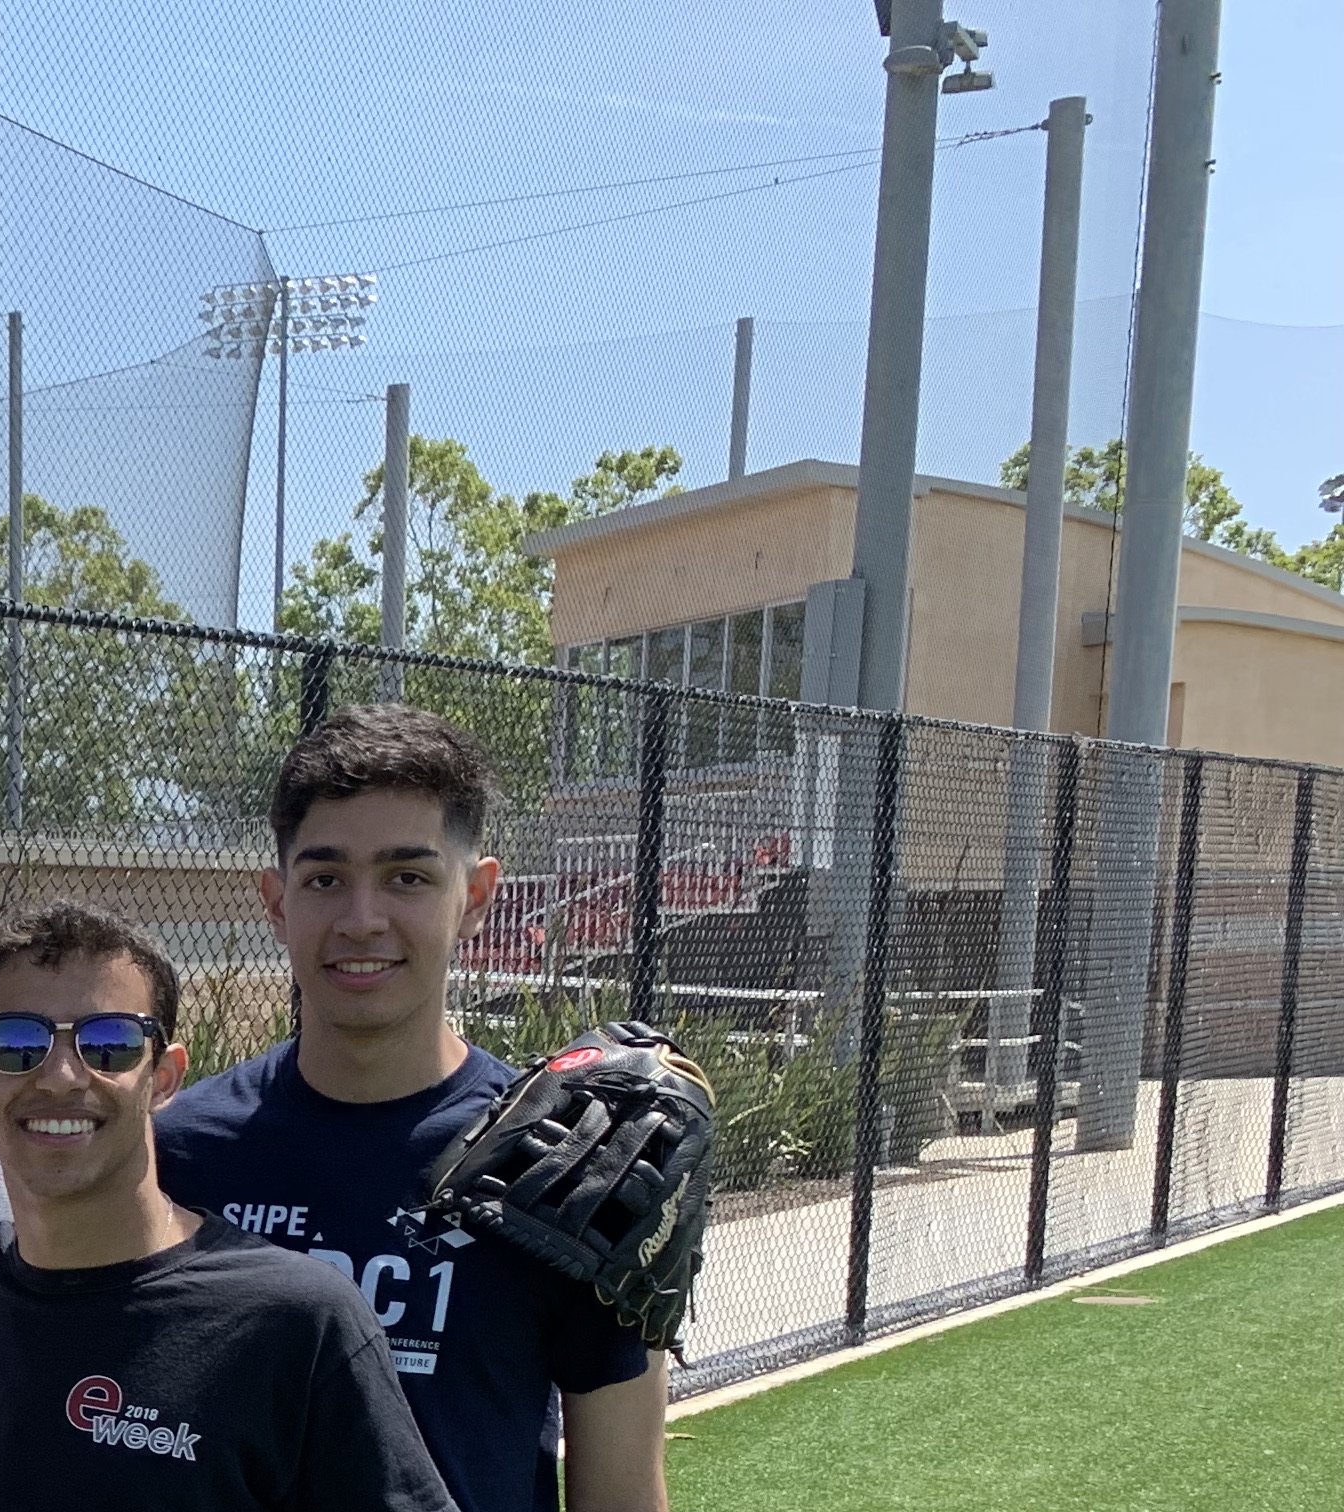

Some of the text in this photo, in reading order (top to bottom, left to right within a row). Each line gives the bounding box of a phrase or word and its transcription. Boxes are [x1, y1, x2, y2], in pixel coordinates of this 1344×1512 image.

[223, 1203, 309, 1236] SHPE
[392, 1356, 431, 1368] UTURE
[124, 1405, 159, 1421] 2018
